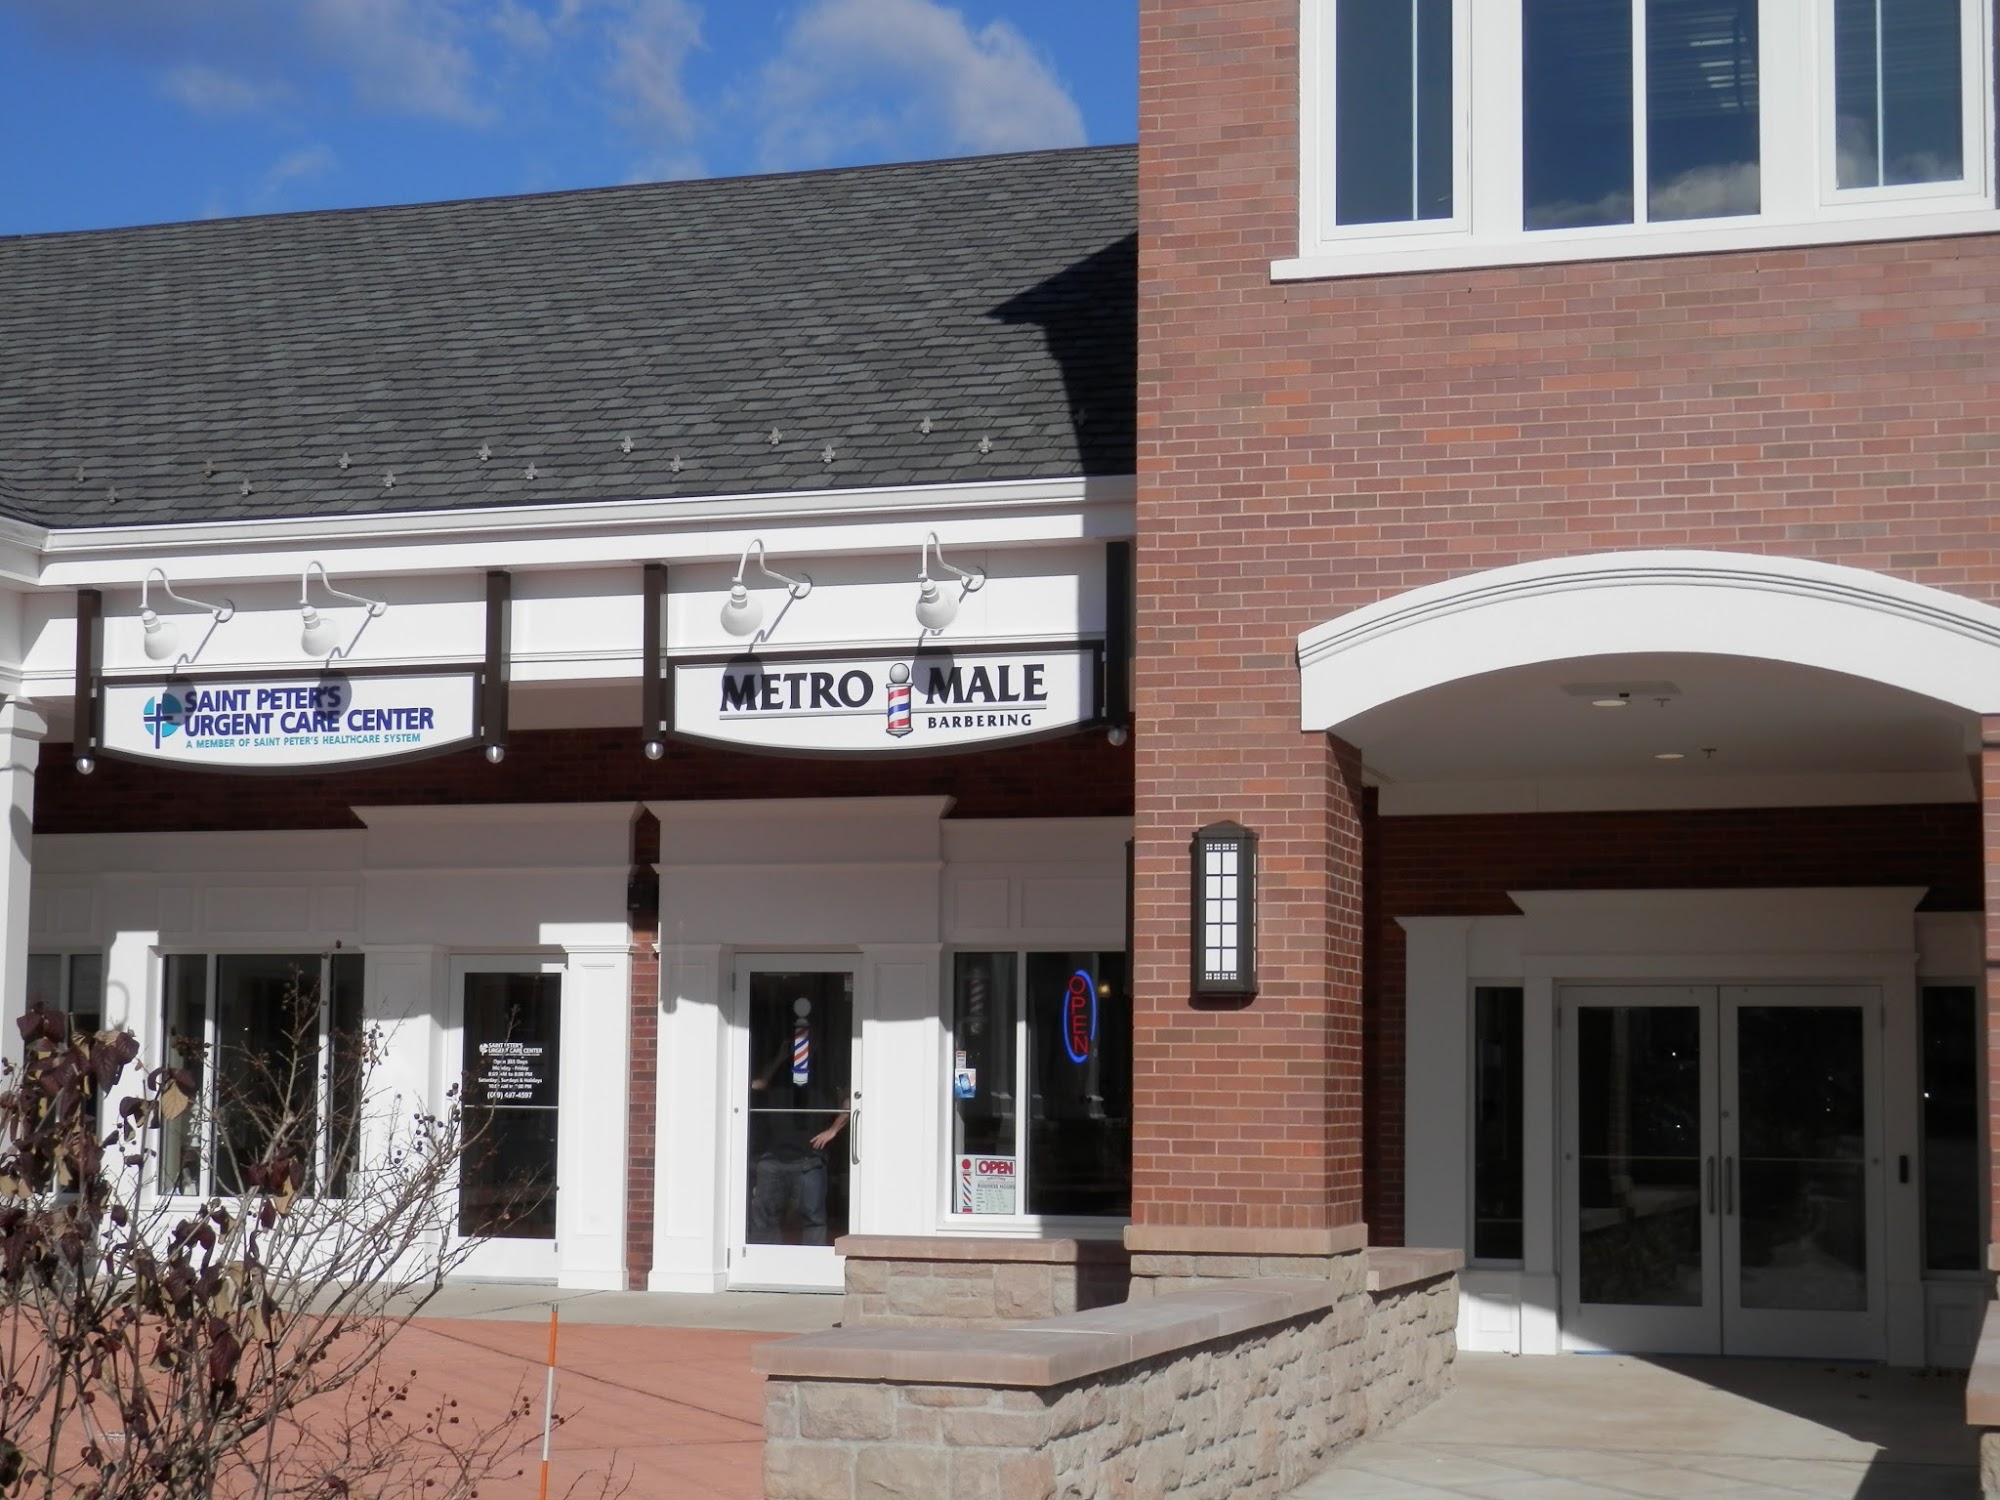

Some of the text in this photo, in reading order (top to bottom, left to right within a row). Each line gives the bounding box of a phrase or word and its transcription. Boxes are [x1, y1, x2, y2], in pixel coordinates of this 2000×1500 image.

[185, 685, 341, 712] SAINT PETER'S
[720, 664, 1048, 711] METRO MALE
[185, 707, 434, 737] URGENT CARE CENTER
[928, 714, 1032, 729] BARBERING
[186, 733, 421, 748] A MEMBER OF SAINT PETER'S HEALTHCARE SYSTEM
[1069, 976, 1089, 1054] OPEN
[979, 1160, 1013, 1174] OPEN
